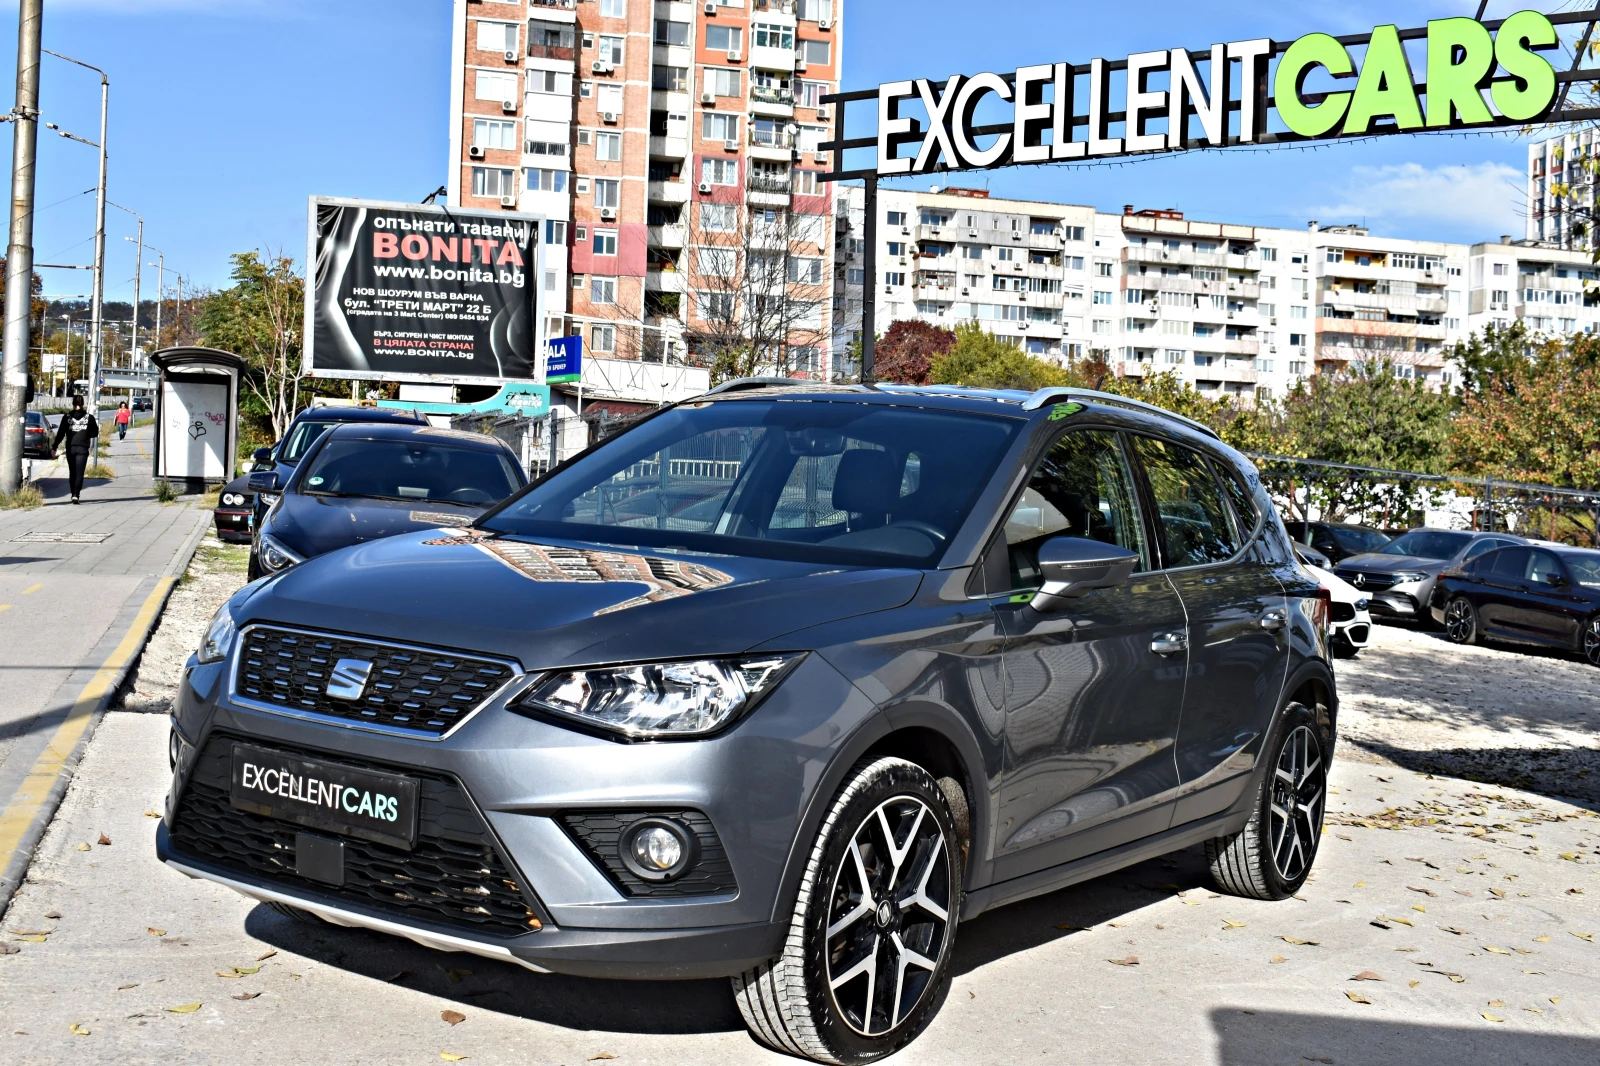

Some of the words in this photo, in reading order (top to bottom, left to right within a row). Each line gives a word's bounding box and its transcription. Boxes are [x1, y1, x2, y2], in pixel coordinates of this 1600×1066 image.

[373, 217, 455, 233] опънати
[460, 223, 525, 239] тавани
[372, 232, 525, 266] BONITA
[373, 265, 525, 287] www.bonita.bg
[353, 287, 376, 296] НОВ
[377, 288, 423, 299] ШОУРУМ
[424, 291, 448, 300] ВЪВ
[449, 292, 484, 301] ВАРНА
[344, 298, 370, 309] бул.
[466, 304, 481, 314] 22
[482, 305, 492, 314] Б
[373, 338, 381, 346] В
[384, 339, 427, 348] ЦЯЛАТА
[429, 341, 474, 349] СТРАНА!
[374, 348, 474, 359] www.BONITA.bg
